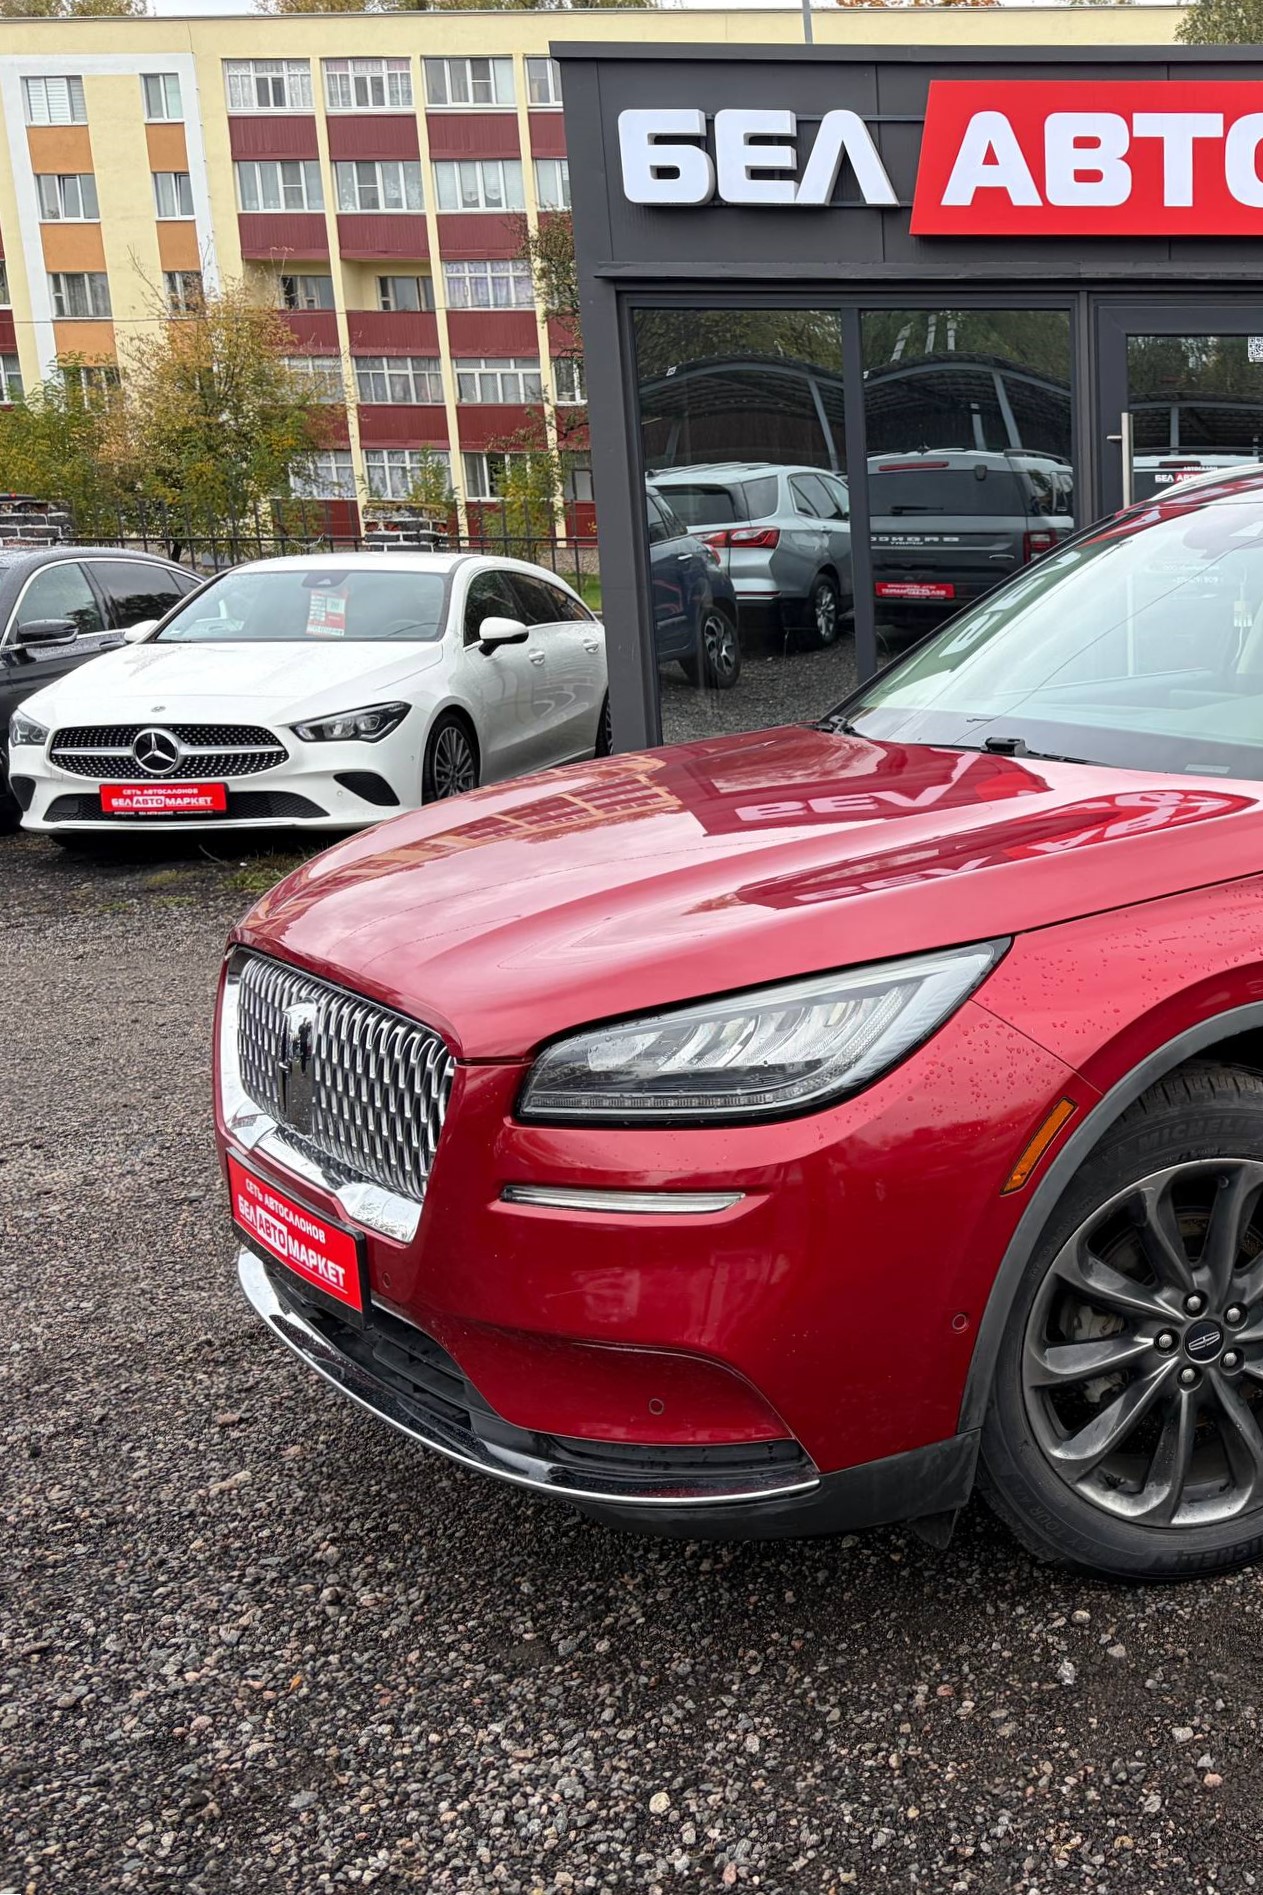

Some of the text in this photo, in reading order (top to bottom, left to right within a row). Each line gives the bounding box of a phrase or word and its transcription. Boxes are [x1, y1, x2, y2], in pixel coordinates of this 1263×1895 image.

[618, 108, 899, 206] БЕЛ
[238, 1194, 346, 1288] БЕЛ АВТО МАРКЕТ
[245, 1178, 326, 1244] СЕТЬ АВТОСАЛОНОВ
